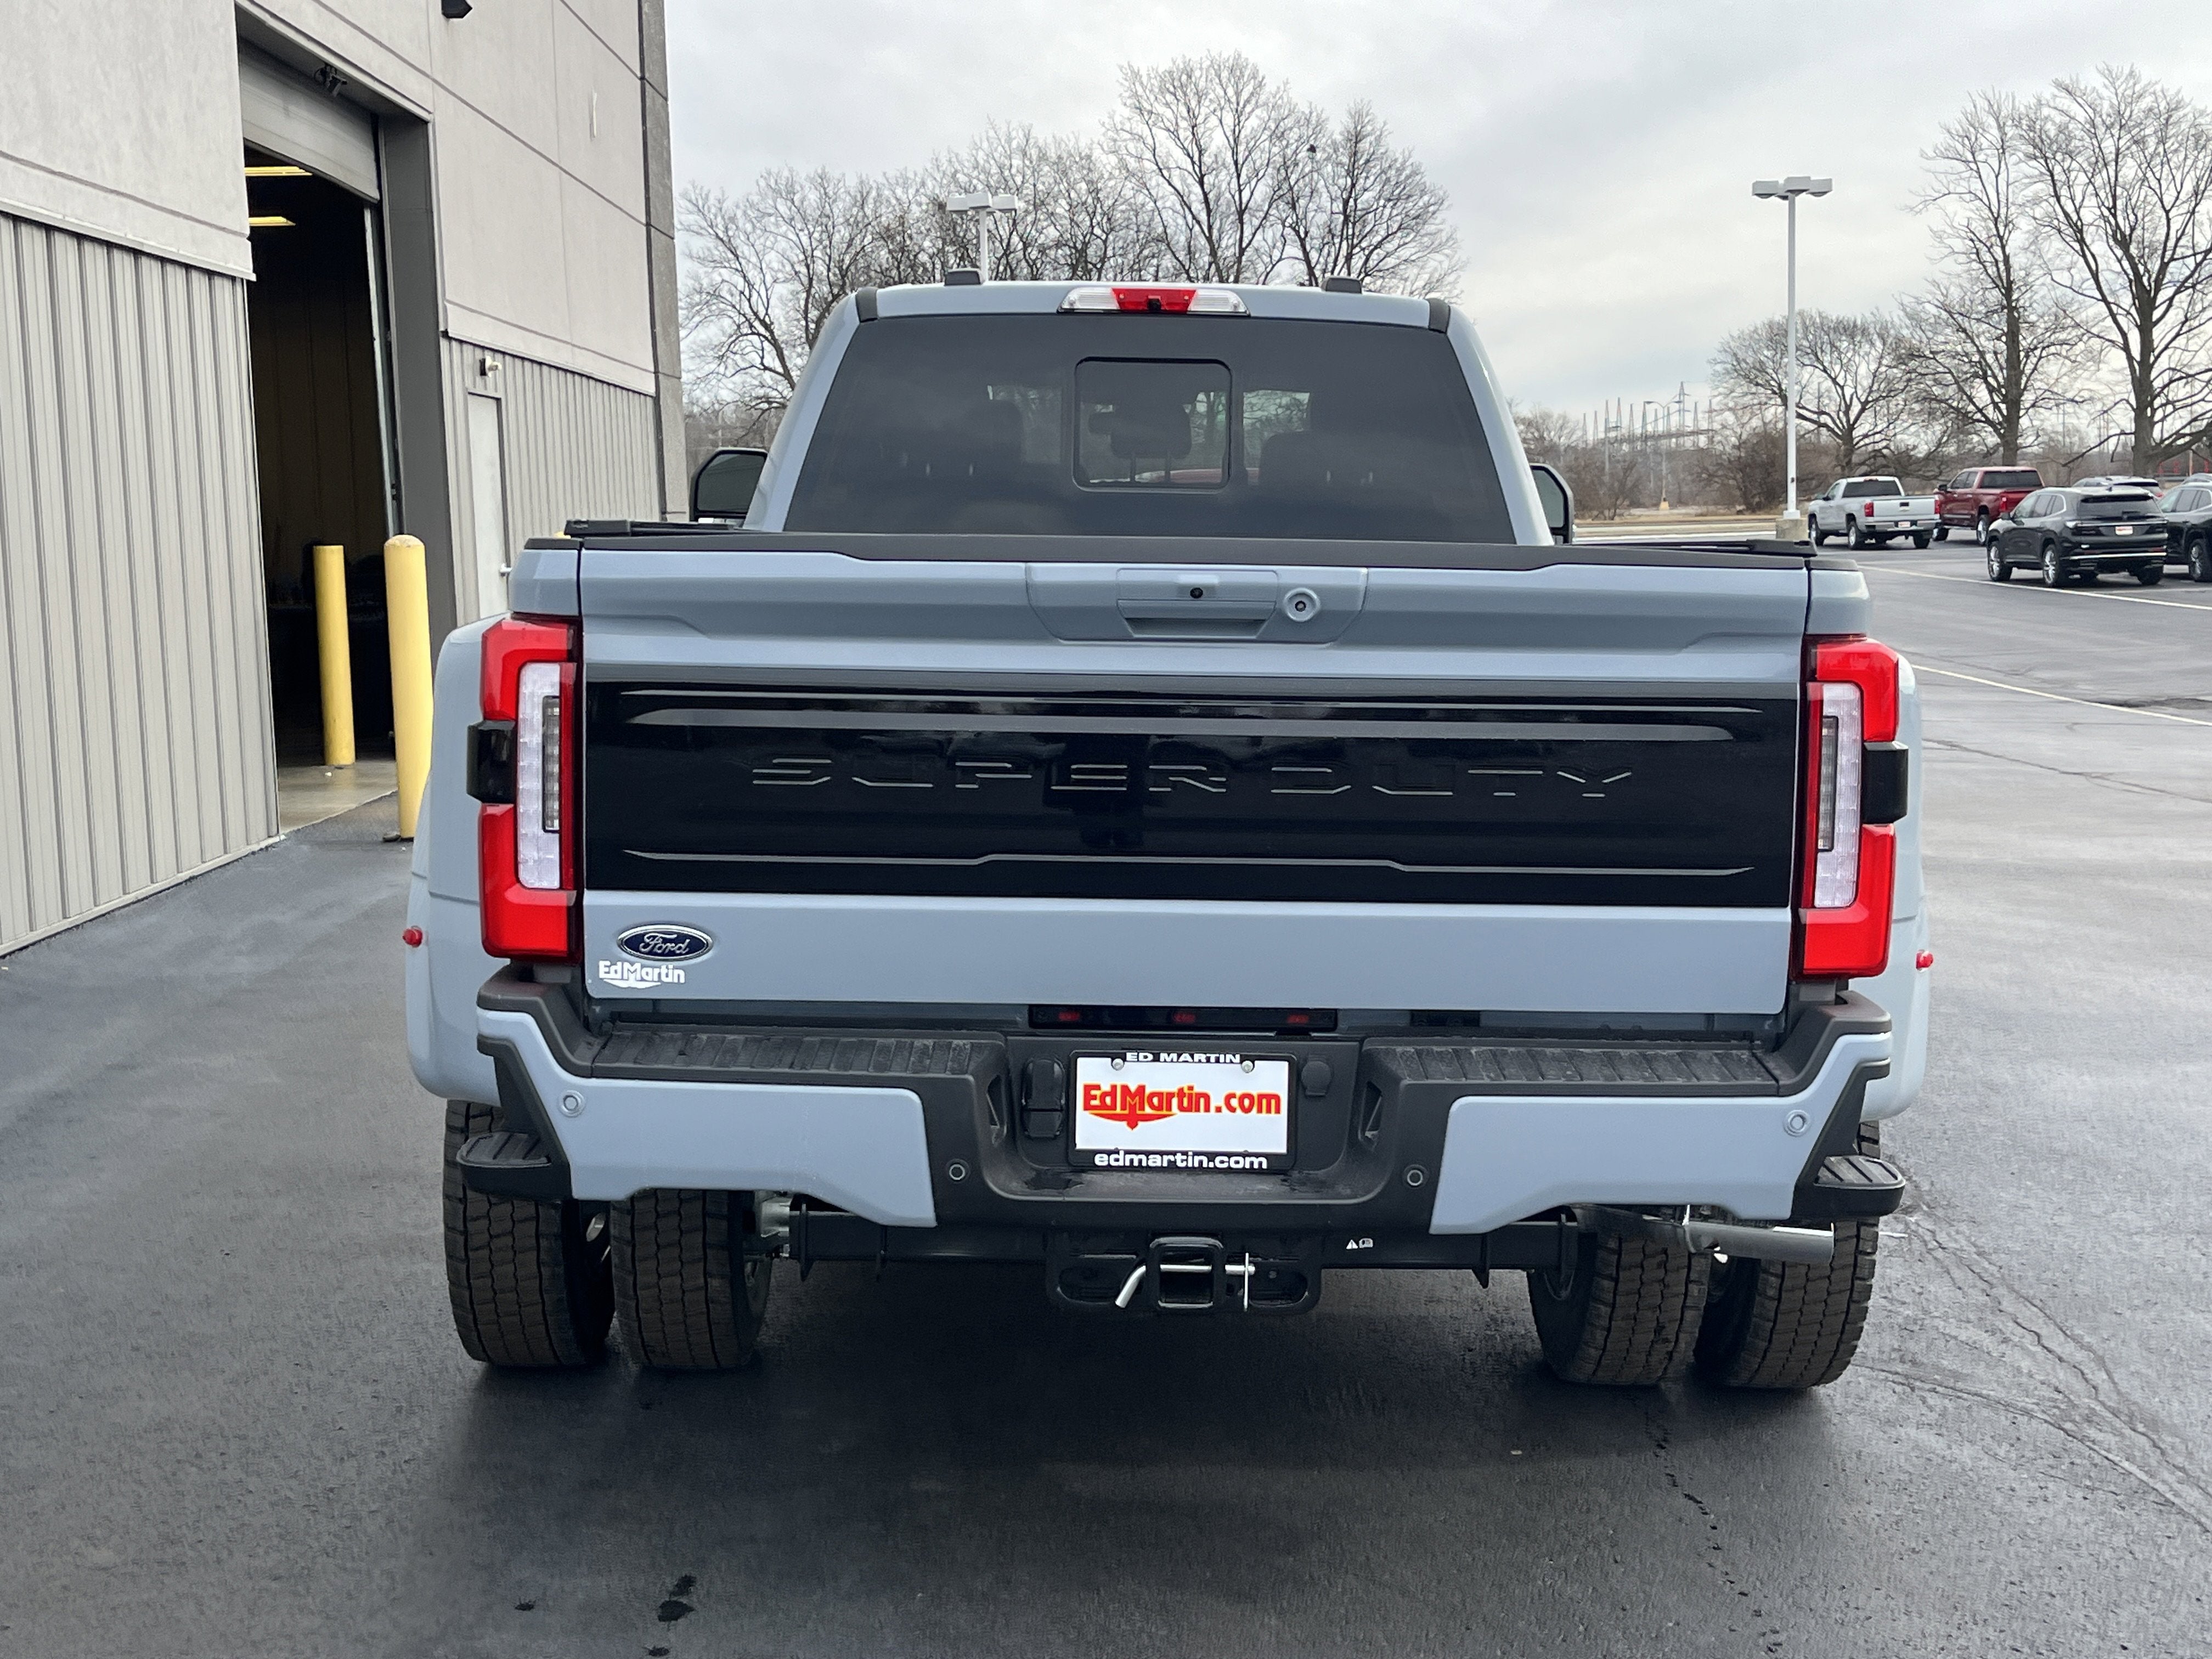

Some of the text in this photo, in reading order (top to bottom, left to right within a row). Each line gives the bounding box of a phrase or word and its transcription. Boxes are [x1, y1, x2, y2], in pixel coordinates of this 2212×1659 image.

[752, 757, 1633, 797] SUPER DUTY
[639, 933, 690, 953] Ford
[1126, 1052, 1240, 1063] ED MARTIN
[1094, 1150, 1267, 1169] edmartin.com
